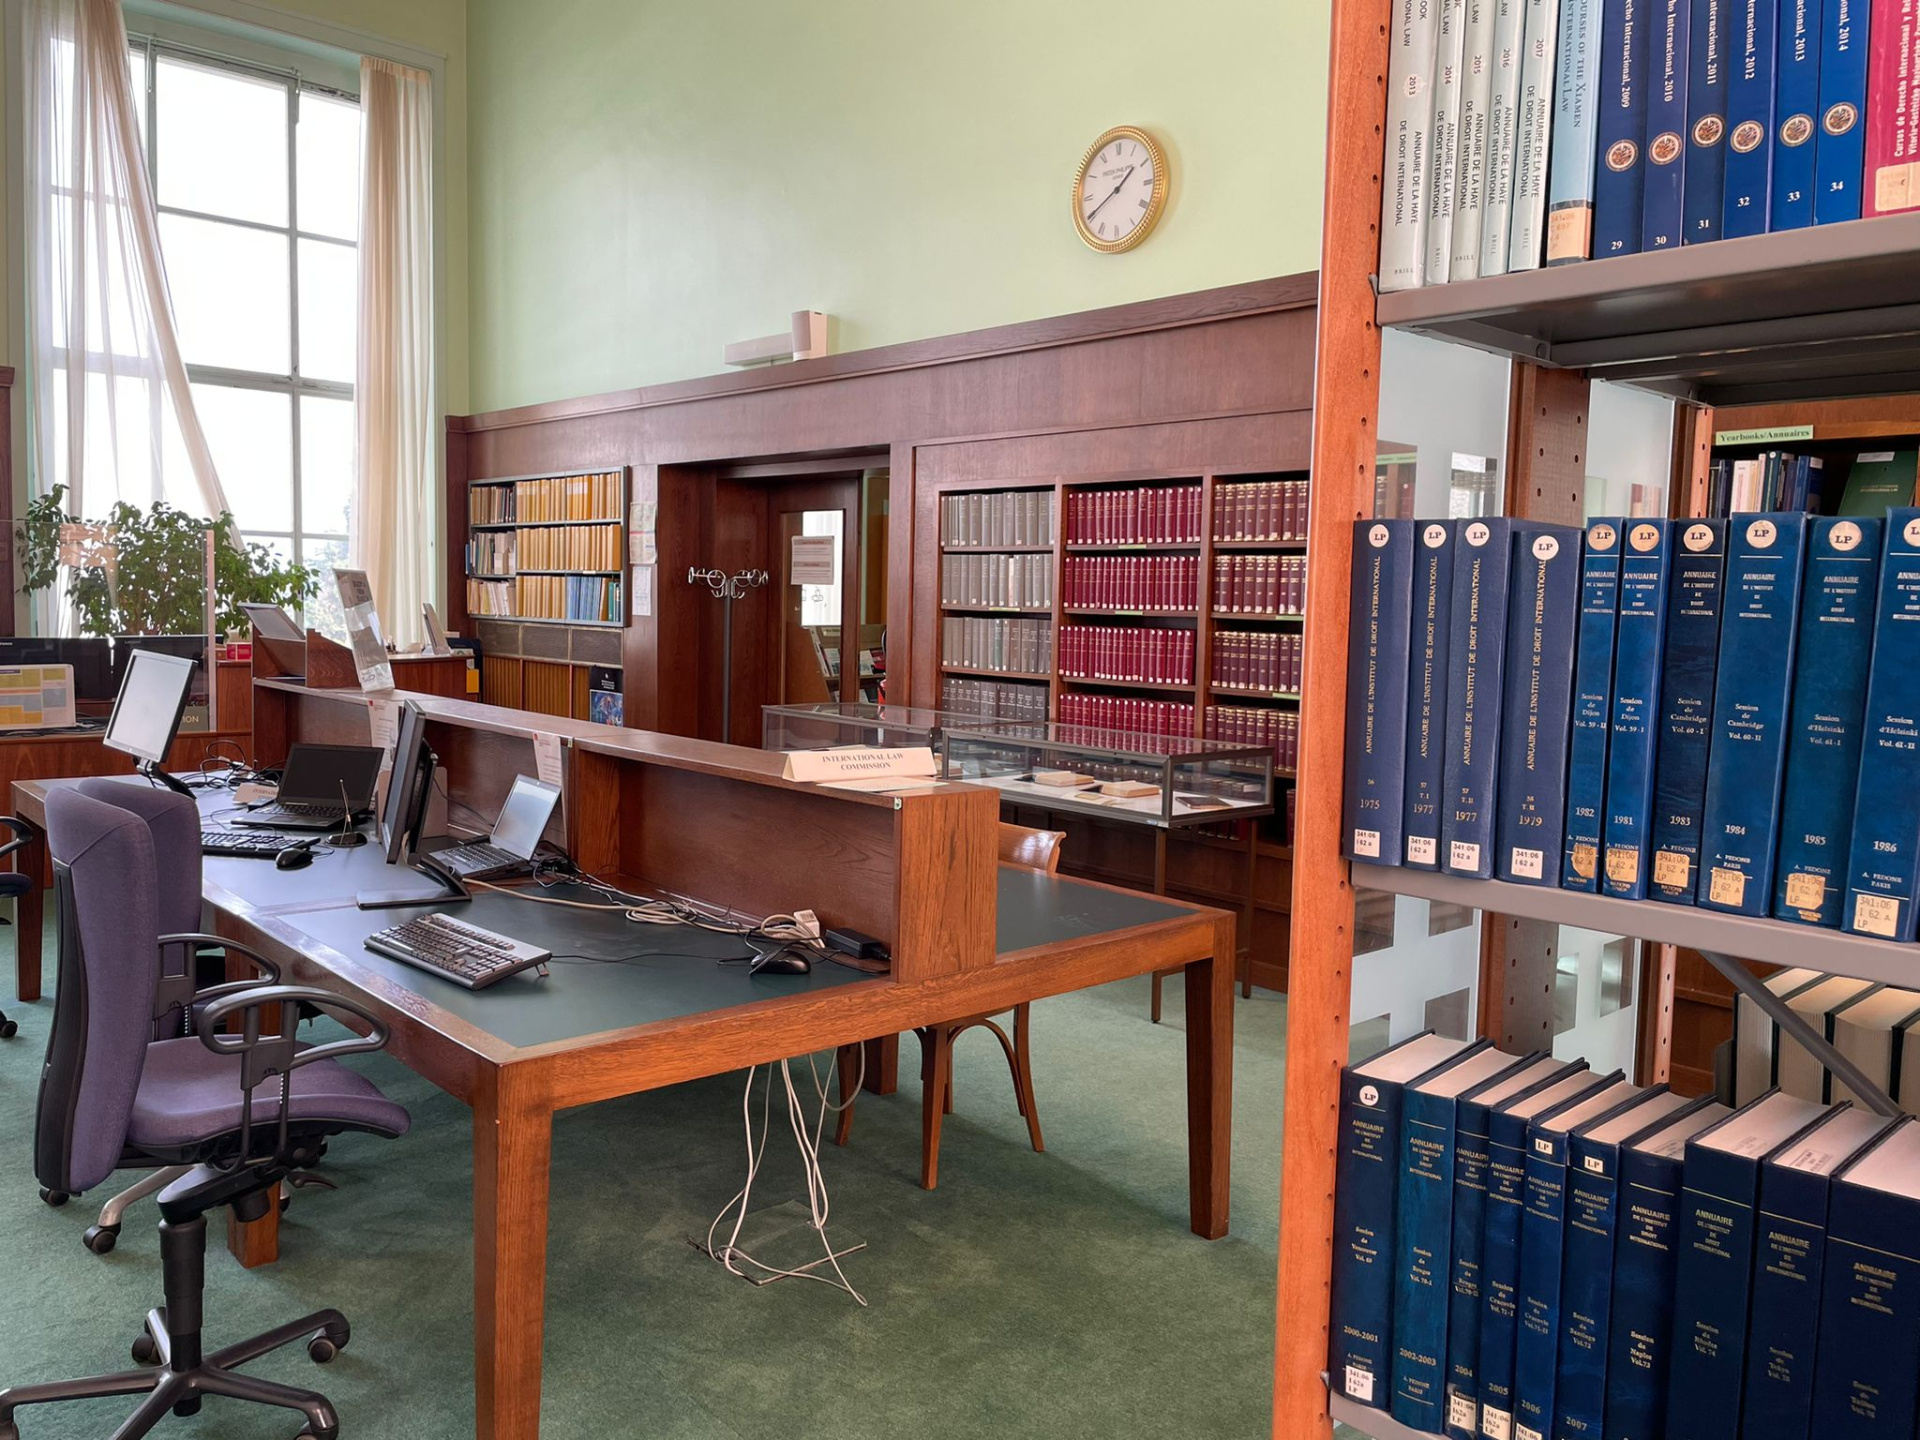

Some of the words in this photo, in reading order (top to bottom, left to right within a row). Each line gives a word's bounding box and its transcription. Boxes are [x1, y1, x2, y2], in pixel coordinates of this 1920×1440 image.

[1442, 17, 1450, 35] LAW
[1579, 0, 1587, 39] OURSES
[1706, 0, 1719, 63] nternacional,
[1563, 0, 1574, 87] NTERNATIONAL
[1838, 26, 1850, 51] 2014
[1536, 39, 1544, 58] 2017
[1621, 21, 1633, 85] Internacional,
[1664, 13, 1676, 80] Internacional,
[1795, 38, 1805, 61] 2013
[1898, 24, 1910, 78] Internacional
[1576, 58, 1585, 80] THE
[1707, 64, 1717, 85] 2011
[1745, 56, 1756, 80] 2012
[1444, 65, 1452, 85] 2014
[1527, 86, 1535, 98] DE
[1621, 88, 1631, 108] 2009
[1664, 82, 1673, 102] 2010
[1896, 80, 1907, 114] Derecho
[1495, 94, 1502, 106] DE
[1466, 101, 1473, 113] DE
[1525, 100, 1534, 127] DROIT
[1437, 110, 1444, 123] DE
[1493, 108, 1501, 136] DROIT
[1535, 98, 1546, 146] ANNUAIRE
[1896, 115, 1906, 127] de
[1399, 120, 1406, 132] DE
[1464, 115, 1472, 144] DROIT
[1502, 106, 1512, 152] ANNUAIRE
[1435, 125, 1443, 151] DROIT
[1474, 112, 1483, 157] ANNUAIRE
[1398, 134, 1406, 159] DROIT
[1445, 123, 1454, 166] ANNUAIRE
[1894, 129, 1904, 157] Cursos
[1413, 131, 1422, 173] ANNUAIRE
[1533, 147, 1542, 159] DE
[1473, 160, 1481, 172] DE
[1502, 153, 1510, 166] DE
[1520, 130, 1532, 199] INTERNATIONAL
[1444, 168, 1452, 180] DE
[1488, 138, 1498, 207] INTERNATIONAL
[1500, 167, 1509, 180] LA
[1532, 161, 1541, 174] LA
[1412, 175, 1420, 186] DE
[1459, 144, 1470, 212] INTERNATIONAL
[1472, 173, 1480, 186] LA
[1432, 153, 1442, 220] INTERNATIONAL
[1443, 182, 1451, 195] LA
[1531, 175, 1540, 198] HAYE
[1830, 181, 1844, 191] 34
[1395, 161, 1405, 227] INTERNATIONAL
[1412, 188, 1419, 201] LA
[1470, 188, 1478, 210] HAYE
[1499, 182, 1508, 205] HAYE
[1787, 192, 1800, 202] 33
[1442, 196, 1451, 218] HAYE
[1737, 197, 1750, 207] 32
[1411, 202, 1419, 224] HAYE
[1698, 219, 1710, 229] 31
[1611, 240, 1623, 250] 29
[1655, 236, 1667, 246] 30
[1720, 430, 1810, 441] Yearbooks/Annuaires
[1596, 532, 1612, 540] LP
[1639, 532, 1655, 540] LP
[1691, 532, 1706, 540] LP
[1753, 529, 1770, 538] LP
[1835, 535, 1852, 544] LP
[1538, 543, 1553, 551] LP
[1743, 573, 1776, 581] ANNUAIRE
[1823, 576, 1859, 584] ANNUAIRE
[1372, 556, 1381, 617] INTERNATIONAL
[1428, 556, 1438, 619] INTERNATIONAL
[1470, 558, 1481, 622] INTERNATIONAL
[1535, 560, 1547, 624] INTERNATIONAL
[1469, 625, 1477, 650] DROIT
[1534, 627, 1542, 652] DROIT
[1370, 646, 1377, 656] DE
[1426, 648, 1433, 659] DE
[1468, 652, 1476, 663] DE
[1532, 655, 1540, 667] DE
[1368, 660, 1377, 700] L'INSTITUT
[1424, 662, 1432, 702] L'INSTITUT
[1466, 666, 1476, 709] L'INSTITUT
[1530, 669, 1540, 713] L'INSTITUT
[1367, 703, 1374, 713] DE
[1423, 705, 1430, 716] DE
[1466, 711, 1473, 722] DE
[1529, 715, 1537, 726] DE
[1670, 713, 1707, 723] Cambridge
[1727, 720, 1764, 730] Cambridge
[1808, 724, 1844, 734] d'Helsinki
[1879, 726, 1918, 736] d'Helsinki
[1365, 715, 1374, 754] ANNUAIRE
[1421, 718, 1429, 758] ANNUAIRE
[1463, 725, 1472, 765] ANNUAIRE
[1527, 728, 1536, 770] ANNUAIRE
[822, 754, 886, 763] INTERNATIONAL
[888, 752, 904, 760] LAW
[840, 762, 891, 770] COMMISSION
[1360, 799, 1380, 810] 1975
[1414, 804, 1434, 814] 1977
[1455, 811, 1477, 822] 1977
[1575, 807, 1595, 817] 1982
[1519, 815, 1543, 826] 1979
[1614, 815, 1634, 826] 1981
[1669, 816, 1691, 826] 1983
[1725, 824, 1746, 835] 1984
[1804, 834, 1826, 845] 1985
[1873, 841, 1897, 853] 1986
[1608, 850, 1636, 860] 341:06
[1658, 853, 1686, 863] 341:06
[1860, 897, 1891, 909] 341:06
[1364, 1093, 1376, 1101] LP
[1352, 1119, 1385, 1133] ANNUAIRE
[1409, 1137, 1444, 1152] ANNUAIRE
[1538, 1141, 1549, 1151] LP
[1490, 1162, 1525, 1176] ANNUAIRE
[1587, 1159, 1600, 1168] LP
[1574, 1188, 1610, 1204] ANNUAIRE
[1344, 1326, 1378, 1342] 2000-2001
[1400, 1348, 1436, 1366] 2002-2003
[1454, 1365, 1473, 1377] 2004
[1488, 1382, 1509, 1396] 2005
[1521, 1399, 1541, 1414] 2006
[1566, 1416, 1588, 1431] 2007
